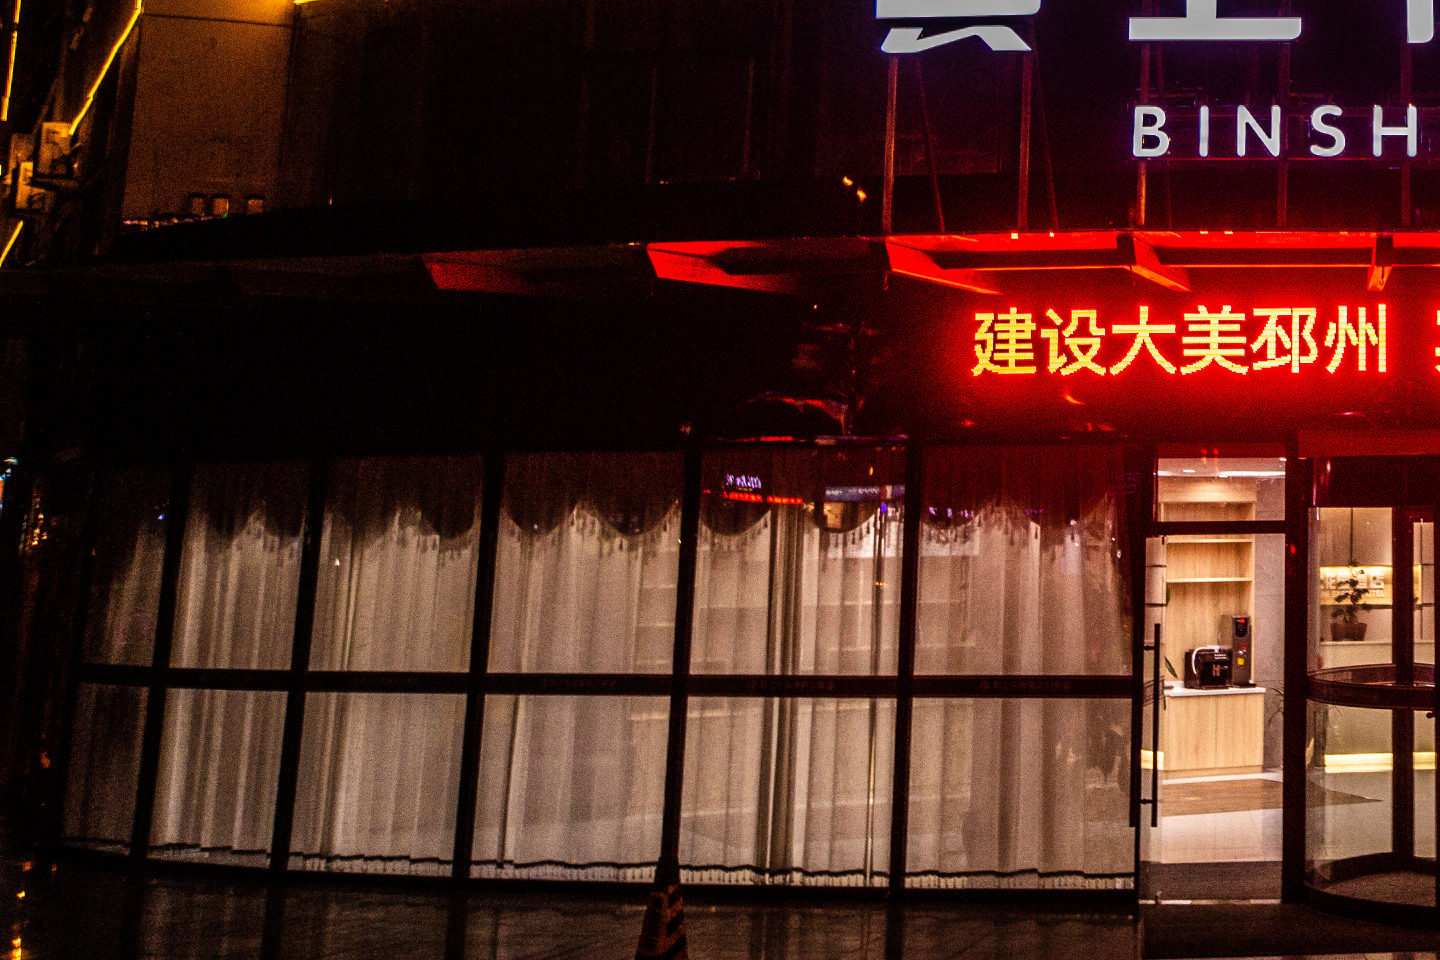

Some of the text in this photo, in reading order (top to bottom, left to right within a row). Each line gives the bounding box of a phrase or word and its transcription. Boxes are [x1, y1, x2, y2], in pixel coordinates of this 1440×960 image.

[970, 303, 1388, 377] 建设大美邳州
